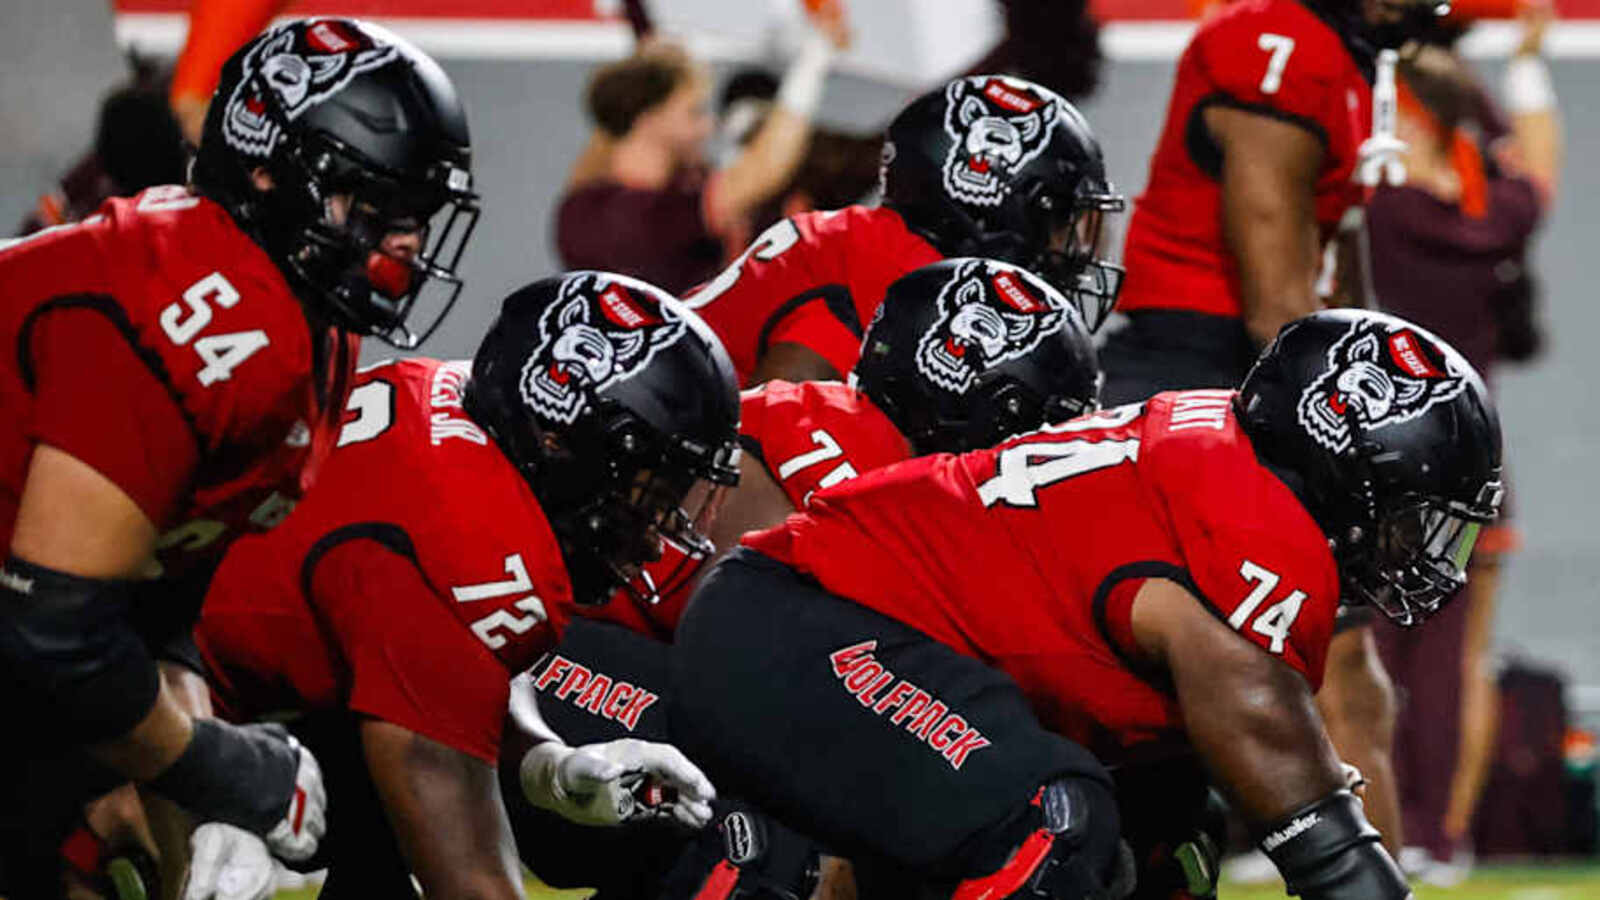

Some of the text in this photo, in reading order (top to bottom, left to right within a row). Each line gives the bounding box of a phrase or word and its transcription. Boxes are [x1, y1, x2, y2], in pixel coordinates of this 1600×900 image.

[1257, 33, 1295, 94] 7
[159, 271, 270, 388] 54
[1400, 350, 1430, 376] STATE
[451, 553, 548, 650] 72
[1228, 559, 1309, 654] 74
[532, 653, 660, 732] FPACK
[829, 639, 992, 770] WOLFPACK
